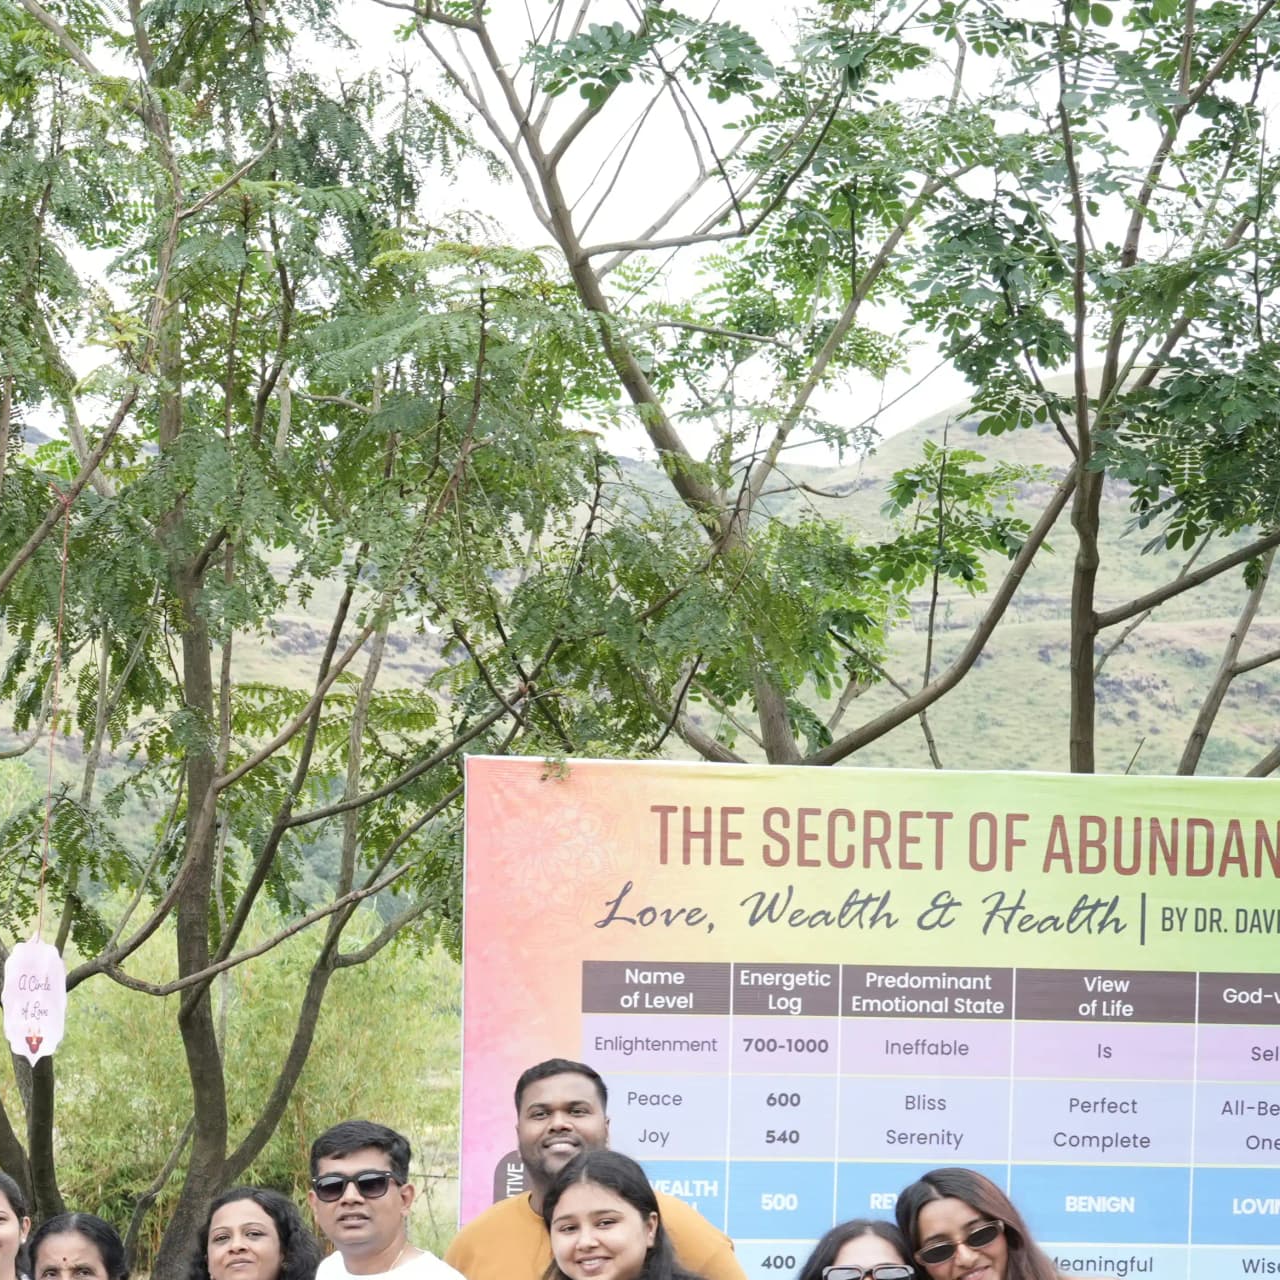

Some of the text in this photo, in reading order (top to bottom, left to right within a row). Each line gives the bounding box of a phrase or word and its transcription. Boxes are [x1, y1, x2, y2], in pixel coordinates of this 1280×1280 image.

[650, 805, 1280, 878] THE SECRET OF ABUNDAN
[594, 880, 715, 934] Love,
[739, 885, 900, 931] Wealth
[917, 889, 963, 931] &
[981, 889, 1128, 936] Health
[1161, 906, 1188, 932] BY
[1193, 907, 1228, 933] DR.
[625, 969, 685, 985] Name
[740, 970, 831, 990] Energetic
[866, 972, 992, 991] Predominant
[1084, 977, 1131, 993] View
[620, 993, 694, 1010] of Level
[768, 994, 802, 1014] Log
[852, 996, 1005, 1015] Emotional State
[1079, 1000, 1134, 1017] of Life
[595, 1036, 717, 1056] Enlightenment
[743, 1038, 829, 1053] 700-1000
[885, 1039, 969, 1056] Ineffable
[1097, 1043, 1112, 1059] Is
[627, 1091, 683, 1107] Peace
[766, 1093, 801, 1107] 600
[904, 1095, 947, 1111] Bliss
[1069, 1098, 1138, 1115] Perfect
[1221, 1100, 1280, 1117] All-Be
[638, 1128, 670, 1147] Joy
[765, 1130, 800, 1144] 540
[886, 1129, 964, 1150] Serenity
[1053, 1131, 1151, 1153] Complete
[761, 1194, 798, 1211] 500
[1065, 1196, 1135, 1213] BENIGN
[761, 1256, 796, 1270] 400
[1242, 1258, 1280, 1274] Wis
